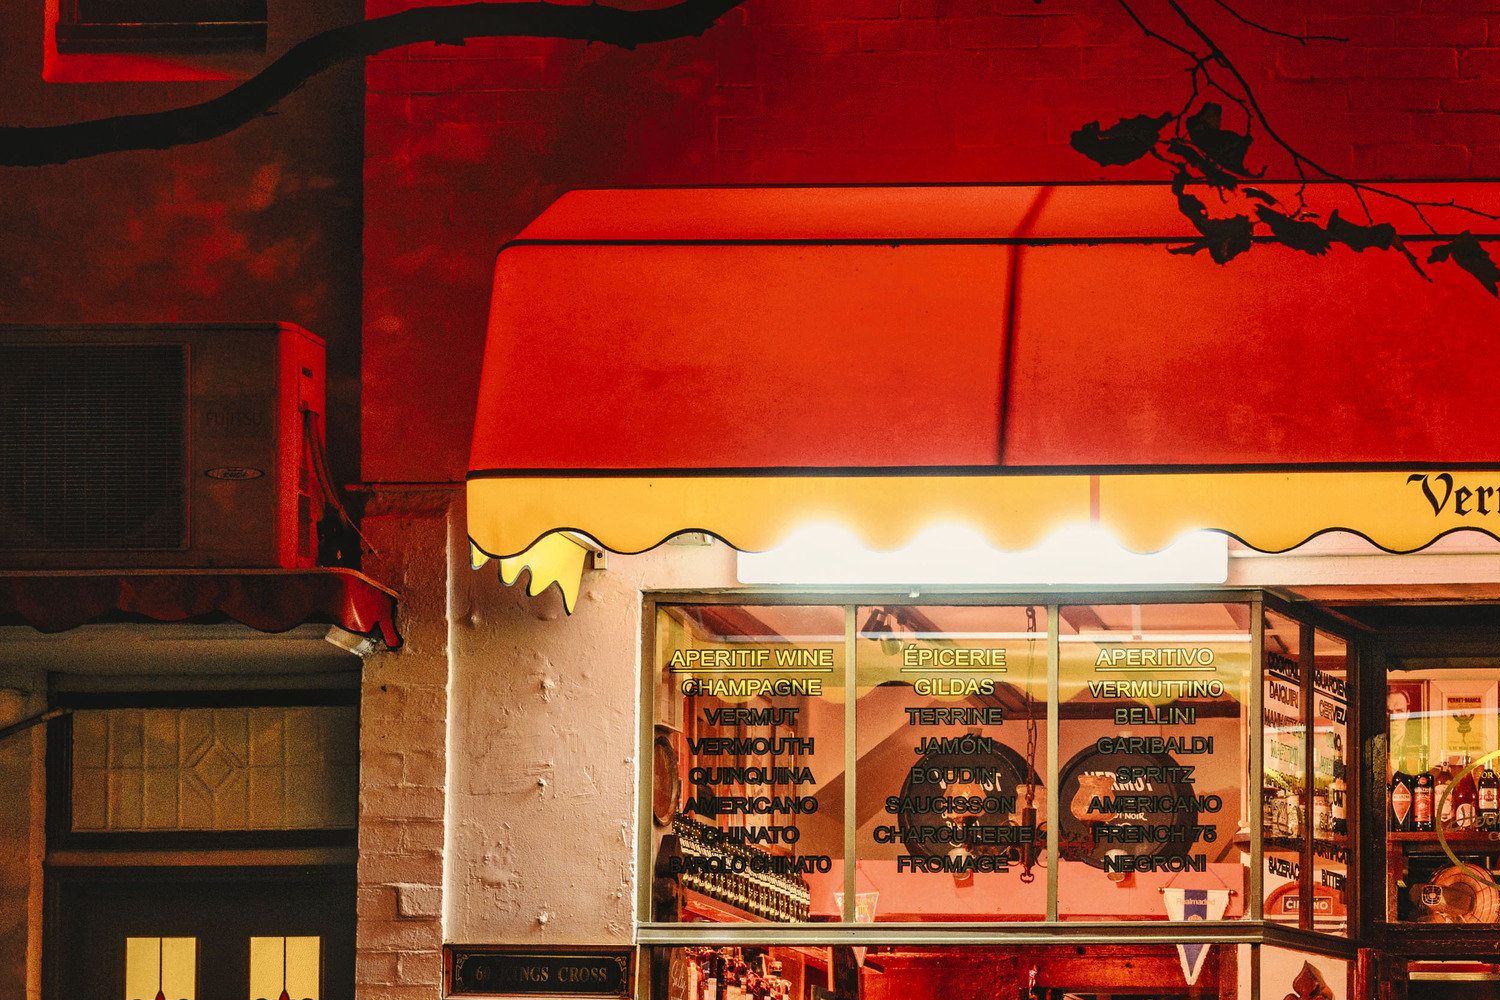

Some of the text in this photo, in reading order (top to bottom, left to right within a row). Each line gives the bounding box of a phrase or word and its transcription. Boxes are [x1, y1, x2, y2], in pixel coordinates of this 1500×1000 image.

[670, 649, 833, 667] APERITIF WINE
[902, 644, 1006, 667] ÉPICERIE
[1096, 648, 1214, 666] APERITIVO
[681, 679, 821, 697] CHAMPAGNE
[914, 678, 995, 696] GILDAS
[1088, 679, 1224, 698] VERMUTTINO
[703, 708, 799, 727] VERMUT
[905, 708, 1003, 726] TERRINE
[1114, 707, 1196, 726] BELLINI
[686, 737, 814, 756] VERMOUTH
[914, 733, 993, 755] JAMÓN
[1097, 737, 1213, 755] GARIBALDI
[688, 767, 816, 785] QUINQUINA
[911, 766, 997, 784] BOUDIN
[1085, 771, 1153, 791] RMUT
[1116, 765, 1196, 784] SPRITZ
[683, 797, 818, 814] AMERICANO
[885, 796, 1016, 814] SAUCISSON
[1087, 795, 1223, 814] AMERICANO
[702, 826, 800, 844] CHINATO
[873, 825, 1034, 844] CHARCUTERIE
[1094, 825, 1217, 843] FRENCH 75
[669, 855, 832, 873] BAROLO CHINATO
[897, 854, 1010, 873] FROMAGE
[1103, 855, 1207, 873] NEGRONI
[1286, 899, 1329, 911] CINO
[558, 967, 607, 982] CROSS
